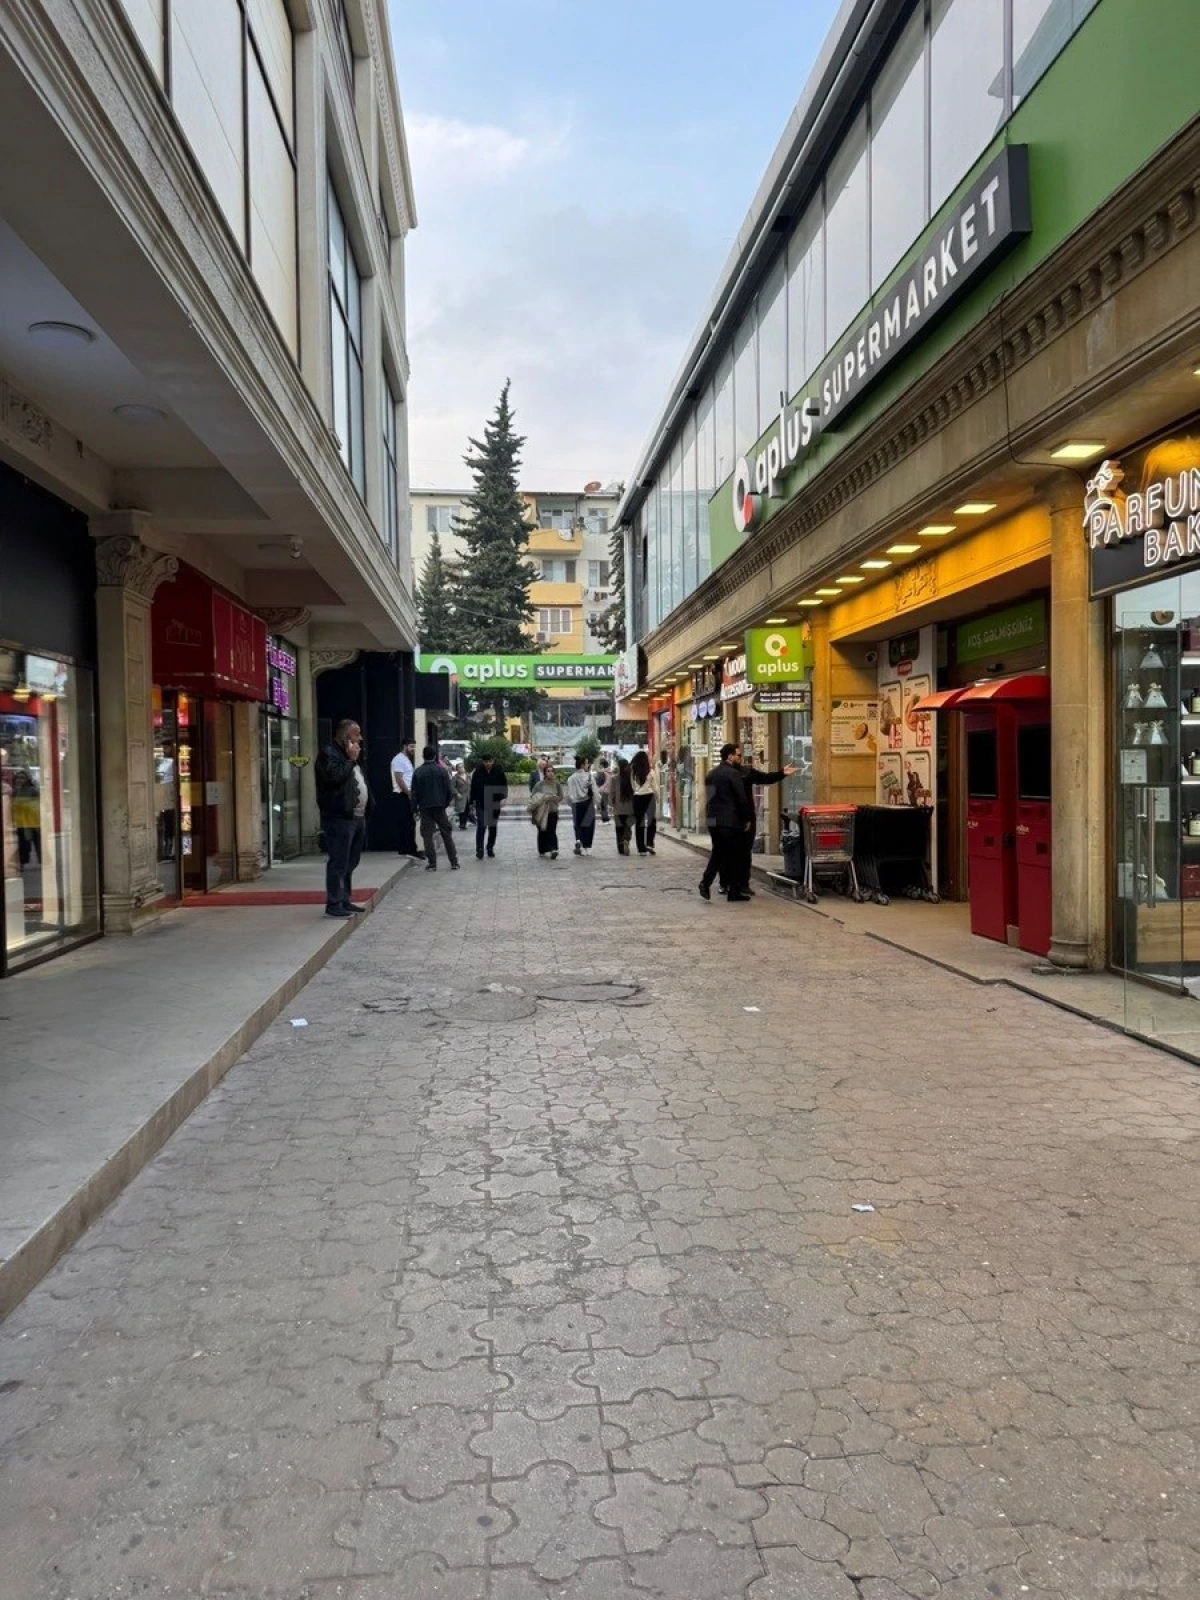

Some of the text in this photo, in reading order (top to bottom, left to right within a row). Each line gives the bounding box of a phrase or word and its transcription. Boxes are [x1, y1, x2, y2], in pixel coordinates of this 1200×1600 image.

[755, 175, 1000, 497] aplus SUPERMARKET
[463, 658, 529, 682] aplus
[757, 659, 800, 677] aplus
